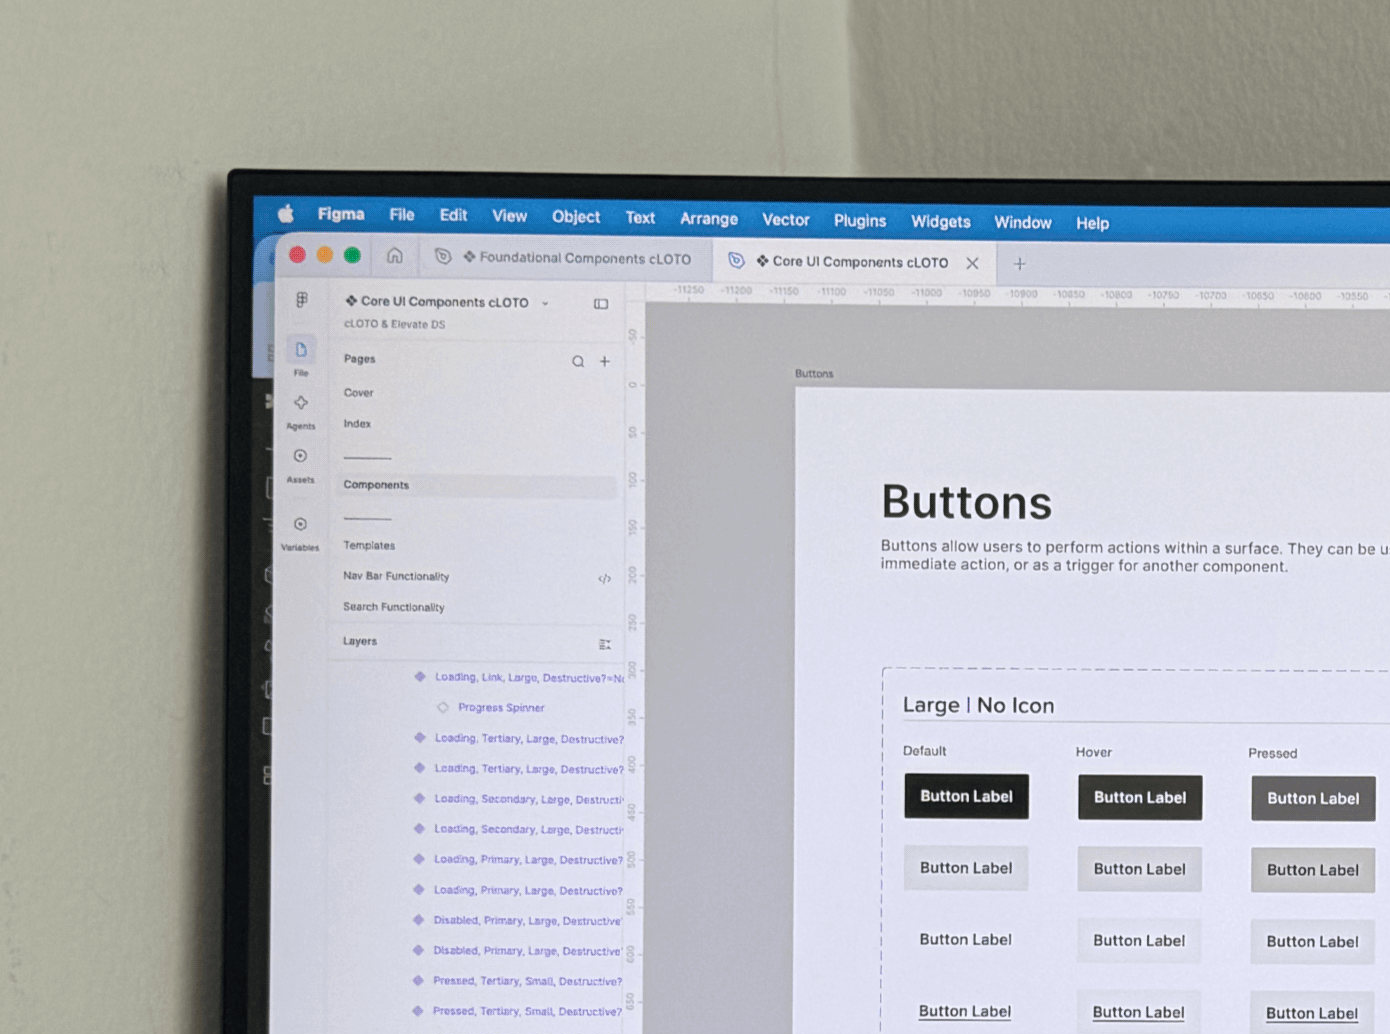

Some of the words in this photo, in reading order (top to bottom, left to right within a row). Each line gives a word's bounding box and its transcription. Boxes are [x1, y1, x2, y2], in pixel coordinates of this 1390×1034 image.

[318, 207, 365, 222] Figma
[390, 208, 415, 221] File
[440, 208, 467, 221] Edit
[493, 209, 527, 222] View
[552, 209, 600, 225] Object
[626, 211, 655, 224] Text
[681, 212, 738, 228] Arrange
[763, 213, 810, 226] Vector
[835, 213, 887, 229] Plugins
[912, 215, 971, 230] Widgets
[995, 216, 1052, 229] Window
[1077, 217, 1109, 232] Help
[480, 251, 561, 263] Foundational
[565, 253, 645, 265] Components
[649, 254, 691, 265] cLOTO
[773, 256, 803, 266] Core
[807, 256, 819, 267] UI
[823, 256, 903, 269] Components
[907, 257, 948, 268] cLOTO
[361, 296, 390, 306] Core
[393, 296, 405, 306] UI
[409, 296, 485, 309] Components
[488, 297, 529, 308] cLOTO
[344, 354, 375, 365] Pages
[796, 369, 834, 378] Buttons
[344, 388, 373, 397] Cover
[344, 420, 371, 428] Index
[344, 480, 409, 490] Components
[884, 484, 1051, 519] Buttons
[344, 541, 395, 550] Templates
[882, 539, 937, 552] Buttons
[942, 541, 978, 552] allow
[983, 543, 1022, 552] users
[1027, 542, 1041, 553] to
[1046, 541, 1103, 557] perform
[1108, 541, 1160, 554] actions
[1165, 542, 1207, 554] within
[1213, 545, 1220, 554] a
[1225, 542, 1282, 554] surface.
[1288, 543, 1323, 557] They
[1328, 546, 1352, 555] can
[1358, 544, 1375, 555] be
[881, 557, 956, 570] immediate
[961, 559, 1009, 572] action,
[1014, 561, 1028, 570] or
[1033, 561, 1049, 571] as
[1054, 562, 1061, 571] a
[1066, 560, 1114, 574] trigger
[1119, 559, 1138, 571] for
[1143, 560, 1199, 572] another
[1203, 562, 1288, 573] component.
[344, 571, 363, 580] Nav
[366, 571, 382, 580] Bar
[386, 571, 449, 583] Functionality
[344, 602, 378, 611] Search
[381, 602, 444, 614] Functionality
[343, 637, 377, 647] Layers
[459, 703, 503, 714] Progress
[507, 703, 545, 713] Spinner
[904, 697, 959, 716] Large
[978, 697, 1005, 713] No
[1013, 697, 1054, 713] Icon
[903, 746, 946, 756] Default
[1076, 747, 1112, 757] Hover
[1249, 748, 1297, 759] Pressed
[921, 789, 969, 802] Button
[974, 790, 1012, 802] Label
[1095, 791, 1143, 803] Button
[1147, 791, 1186, 804] Label
[1268, 792, 1316, 804] Button
[1321, 792, 1359, 805] Label
